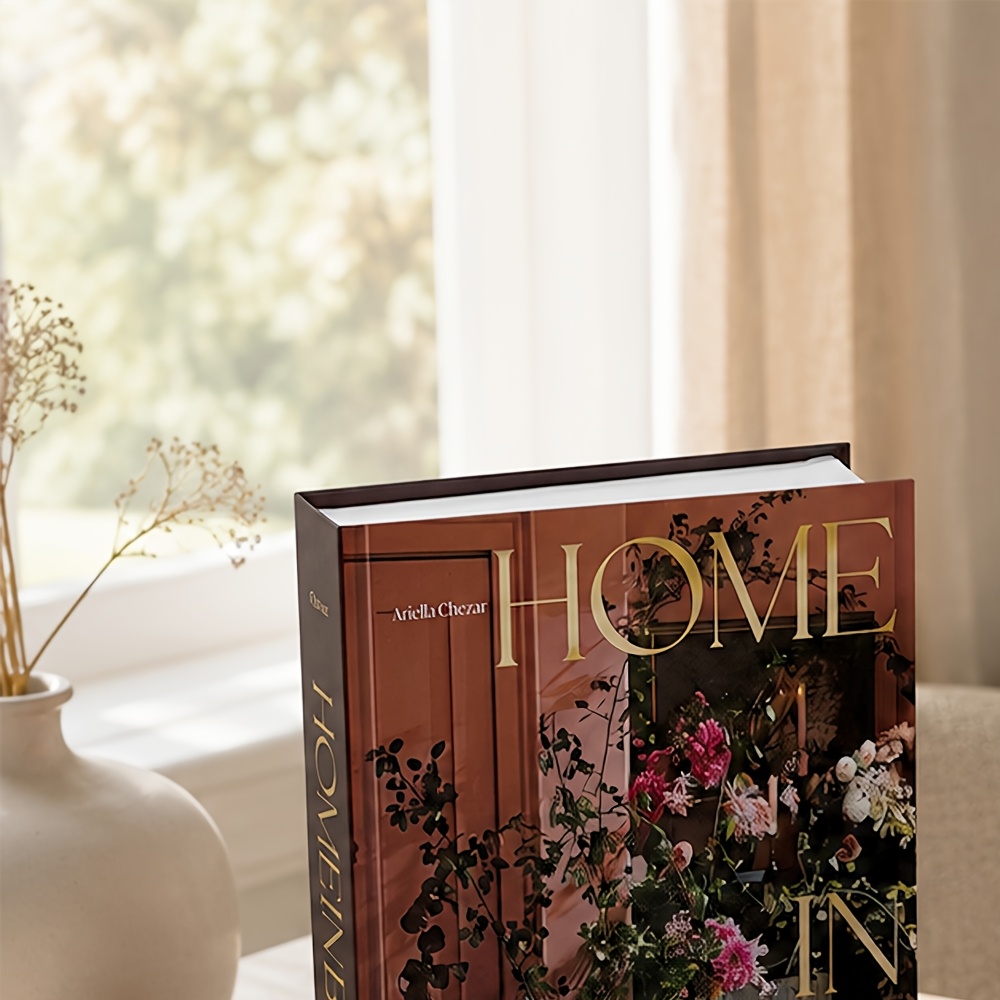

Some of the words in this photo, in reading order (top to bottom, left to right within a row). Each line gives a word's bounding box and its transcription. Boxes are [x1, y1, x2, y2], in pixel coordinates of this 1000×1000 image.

[392, 603, 436, 621] Ariella
[438, 601, 488, 618] Chezar
[496, 517, 898, 667] HOME
[788, 889, 903, 998] IN
